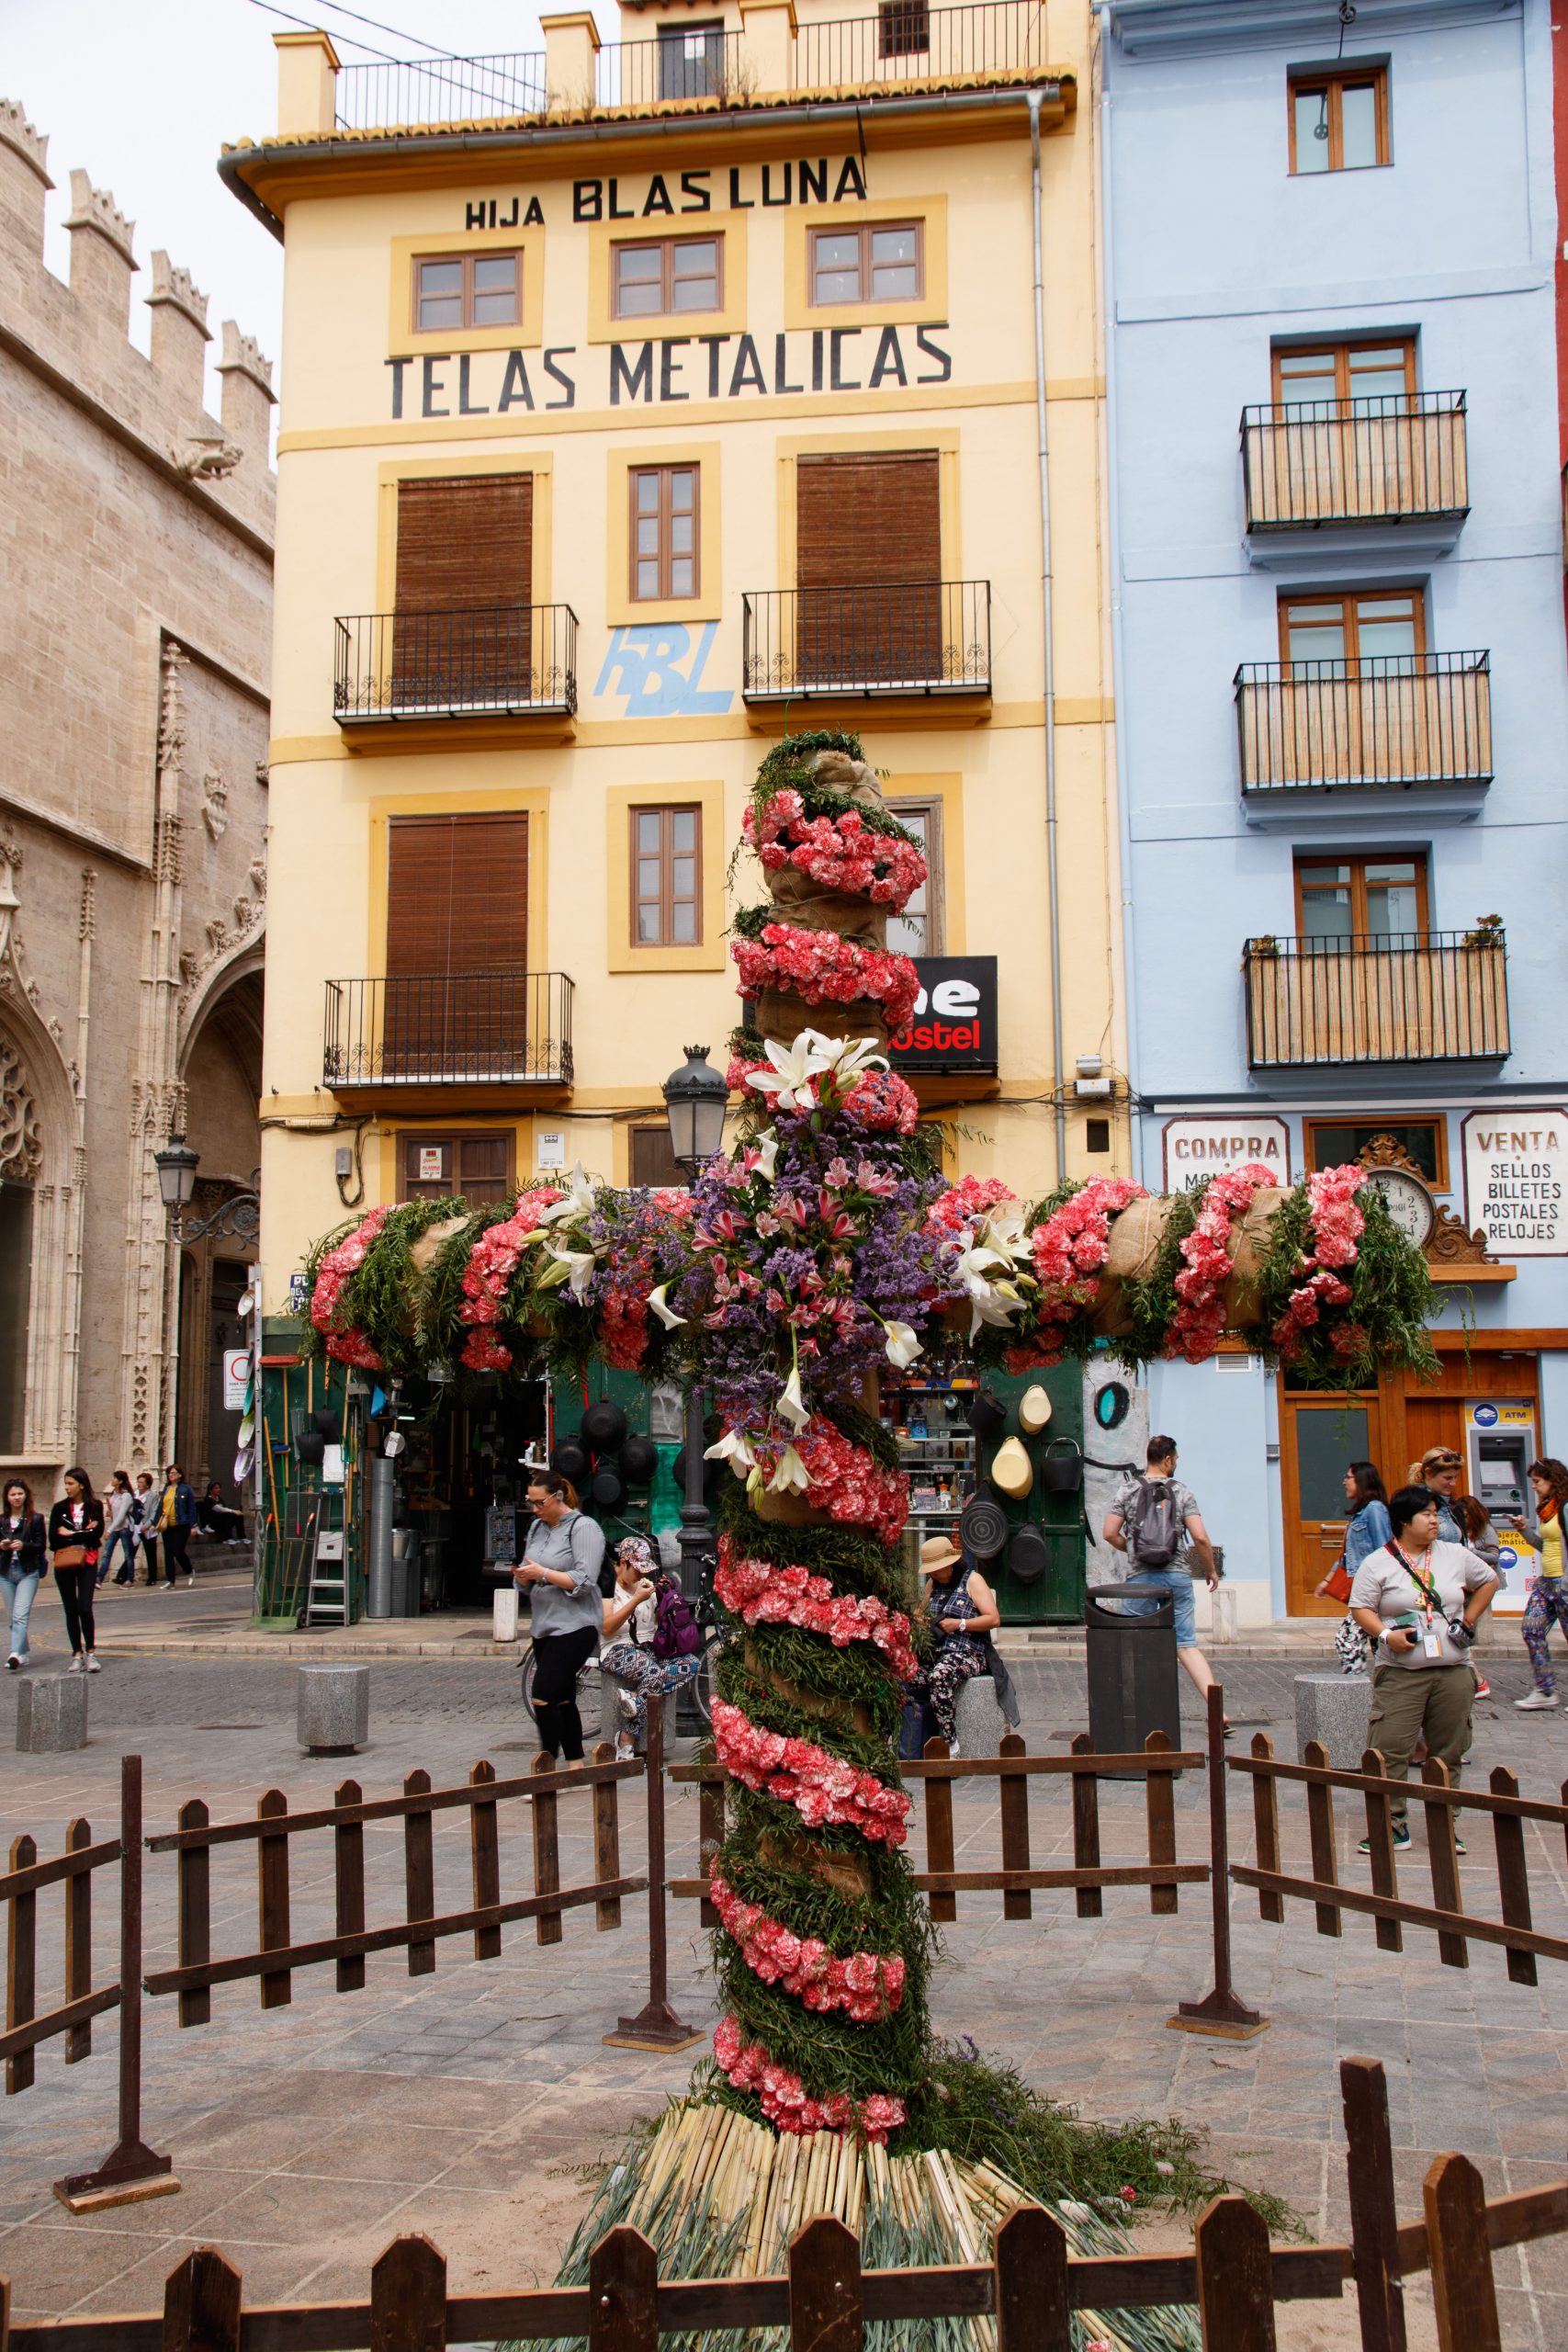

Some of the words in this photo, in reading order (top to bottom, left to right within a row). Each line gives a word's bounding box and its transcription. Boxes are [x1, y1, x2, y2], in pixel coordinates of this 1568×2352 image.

[465, 196, 546, 230] HIJA
[572, 170, 712, 223] BLAS
[729, 155, 867, 209] LUNA
[384, 346, 577, 420] TELAS
[609, 322, 952, 405] METALICAS
[1175, 1136, 1280, 1159] COMPRA
[1476, 1131, 1560, 1152] VENTA
[1491, 1163, 1551, 1179] SELLOS
[1488, 1182, 1562, 1199] BILLETES
[1483, 1204, 1559, 1220] POSTALES
[1489, 1223, 1556, 1240] RELOJES
[1505, 1411, 1527, 1419] ATM
